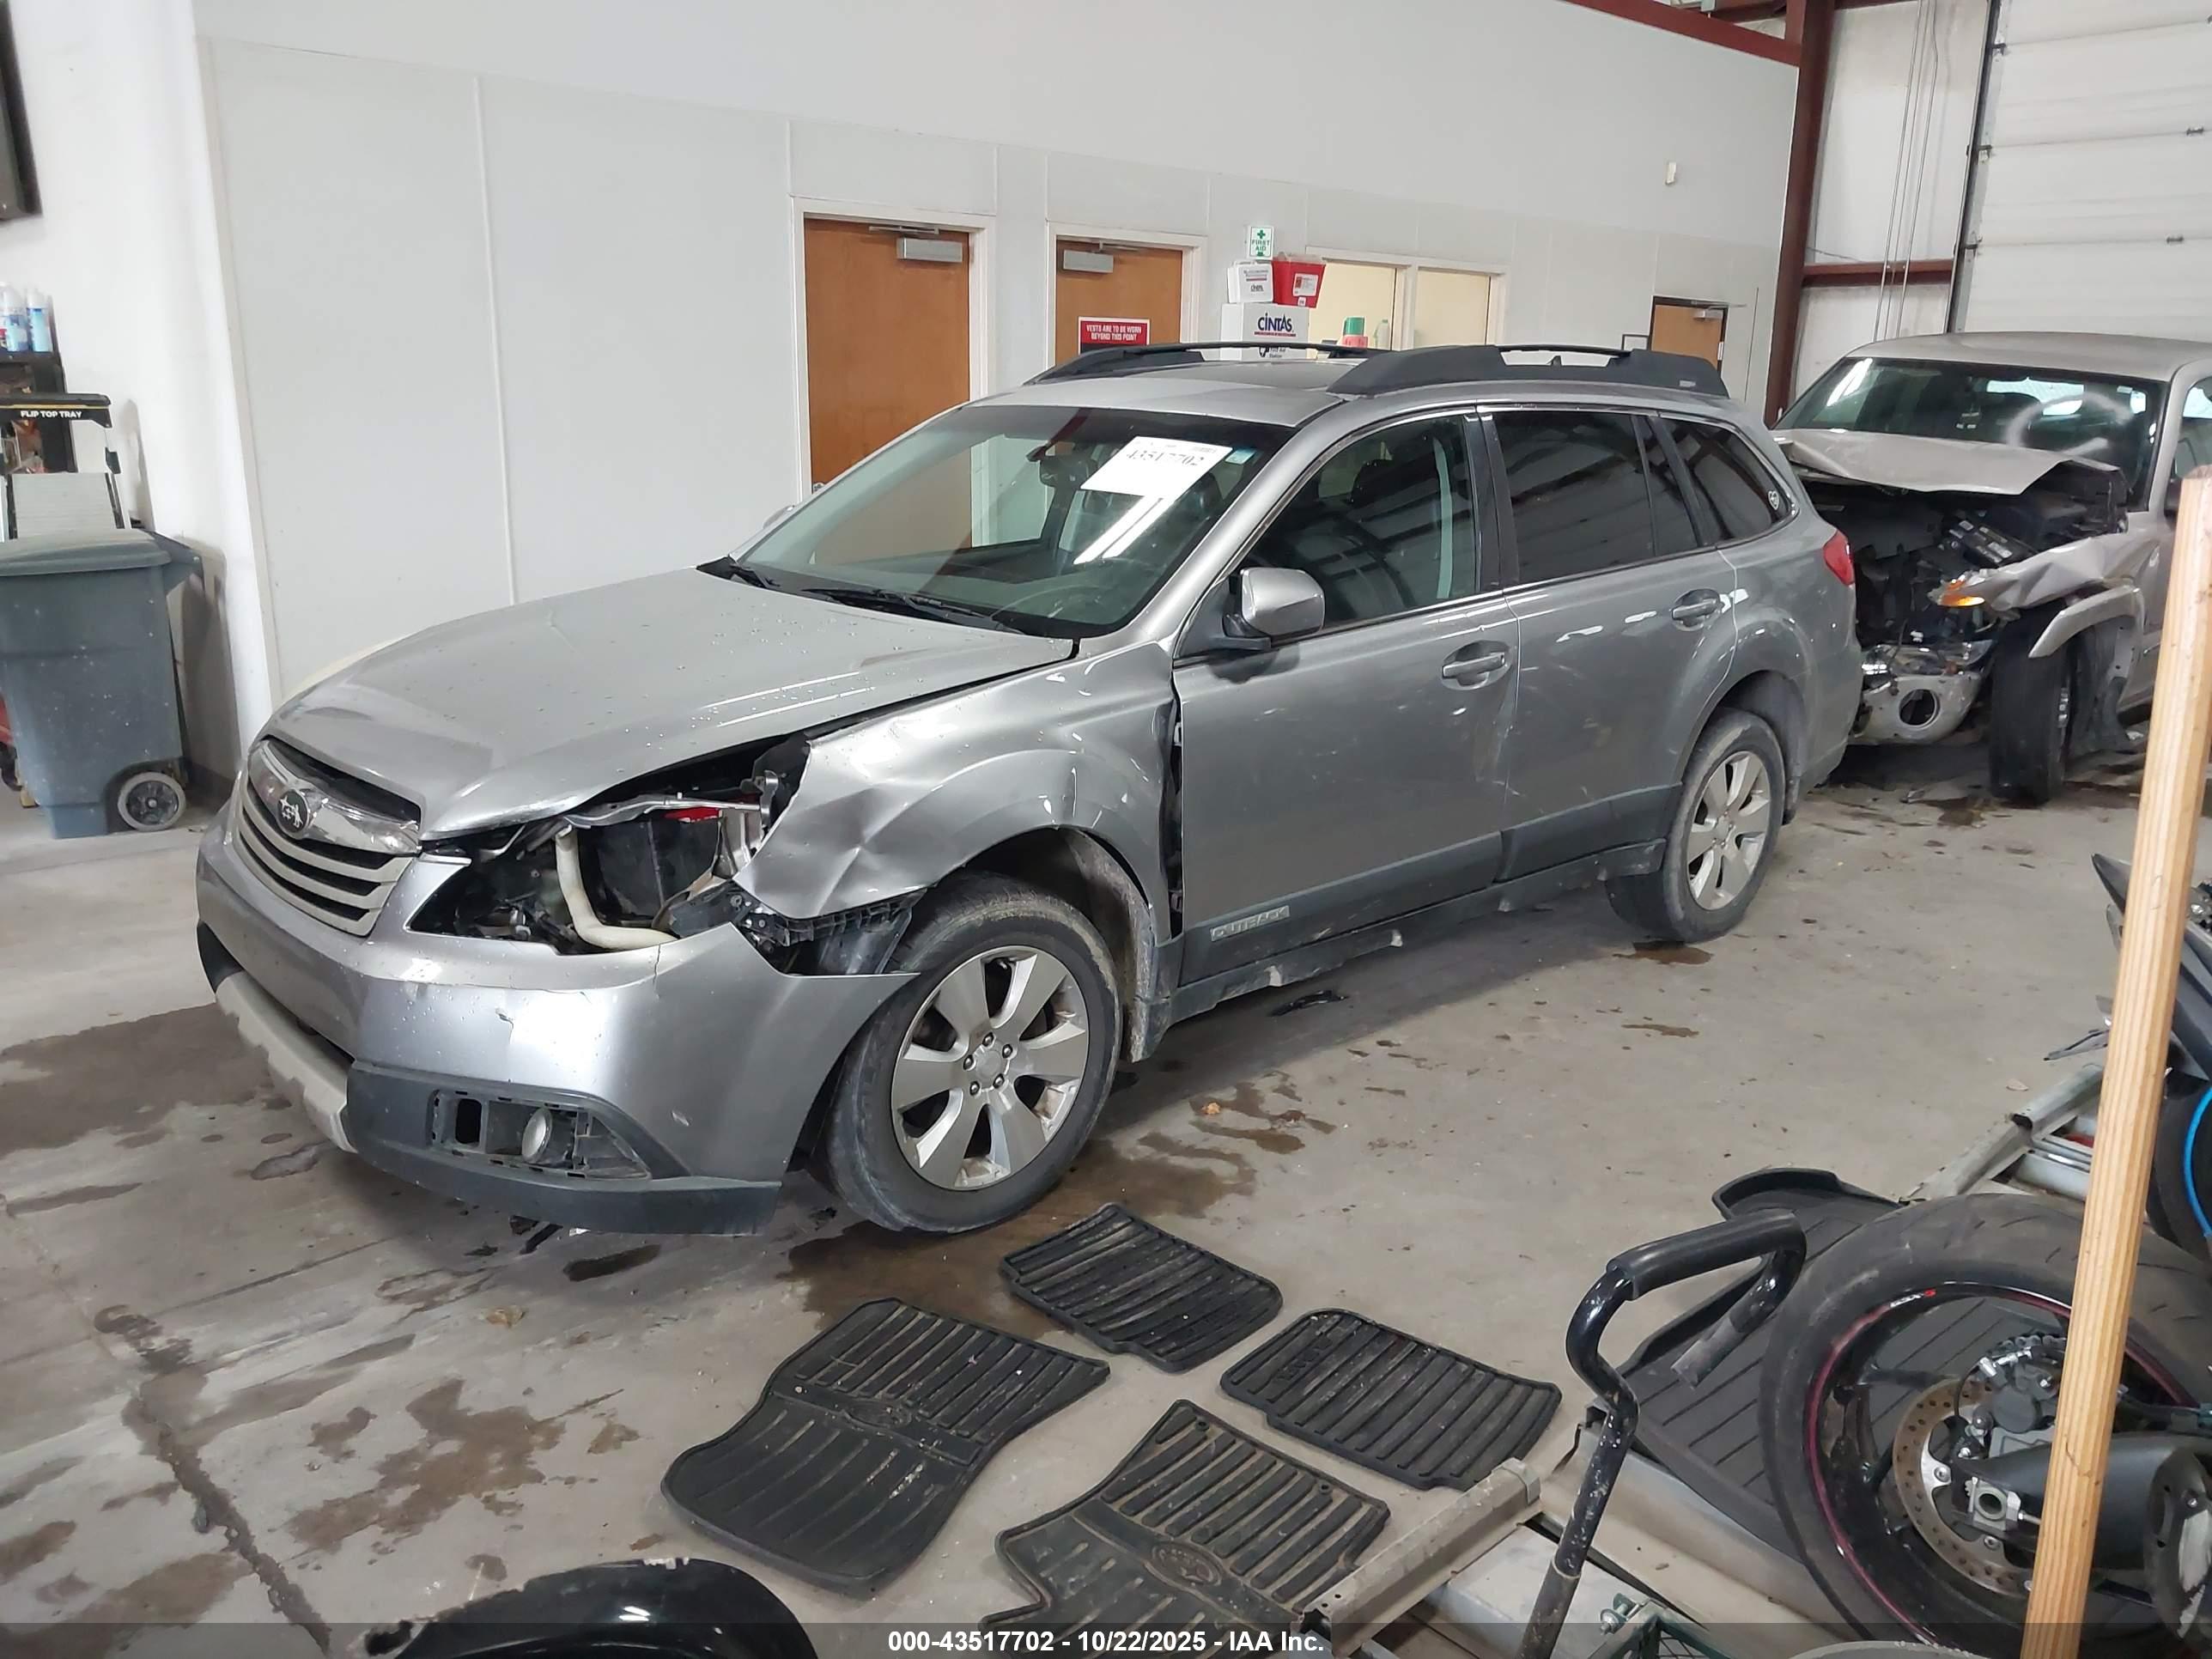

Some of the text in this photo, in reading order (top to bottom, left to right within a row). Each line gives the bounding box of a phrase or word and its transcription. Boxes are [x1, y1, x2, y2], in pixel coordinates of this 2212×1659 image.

[1258, 312, 1292, 332] CINTAS
[1103, 325, 1112, 333] ARE
[59, 410, 82, 419] TRAY
